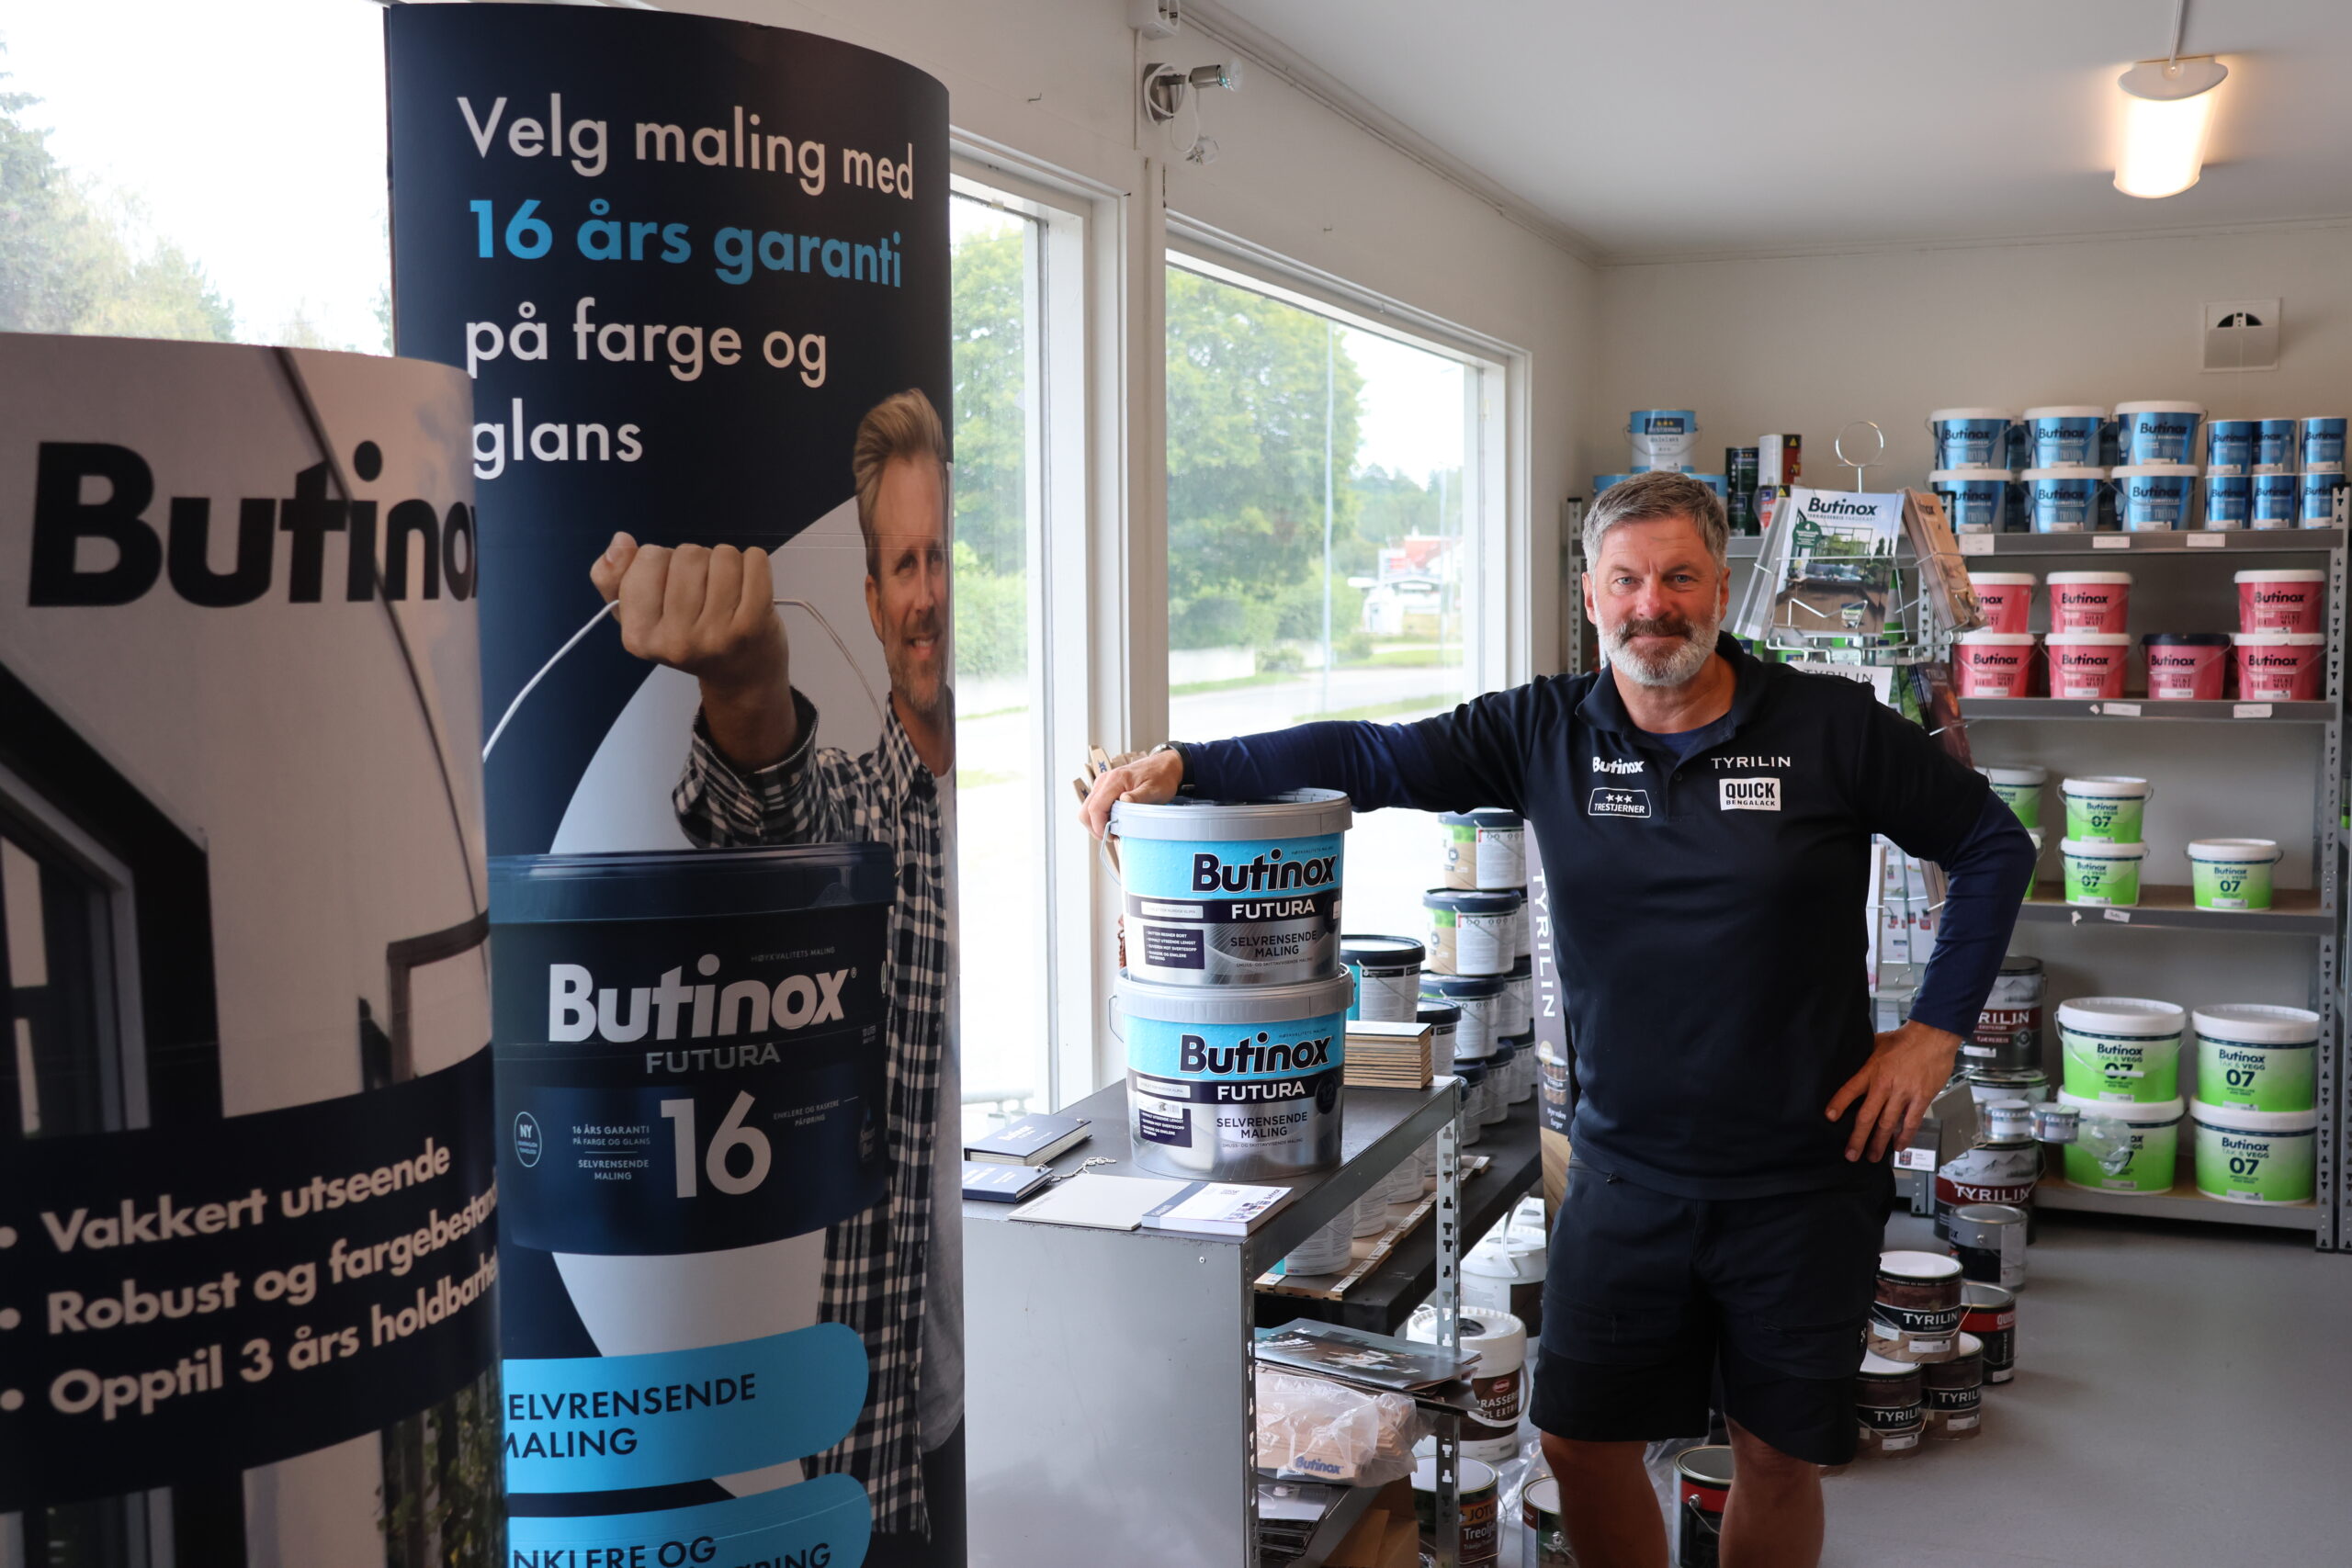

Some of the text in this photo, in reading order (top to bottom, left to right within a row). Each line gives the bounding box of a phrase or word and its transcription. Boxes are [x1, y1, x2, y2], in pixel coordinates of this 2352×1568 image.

[457, 93, 914, 200] Velg maling med
[469, 197, 902, 288] 16 års garanti
[466, 297, 827, 389] på farge og
[472, 397, 643, 480] glans
[1944, 427, 1990, 440] Butinox
[1956, 488, 1992, 501] utinox
[1808, 497, 1878, 515] Butinox
[28, 440, 477, 608] Butino
[1978, 592, 2003, 604] inox
[2062, 592, 2108, 604] Butinox
[2255, 591, 2304, 604] Butinox
[1973, 653, 2018, 665] Butinox
[2062, 653, 2109, 666] Butinox
[2151, 655, 2196, 666] Butinox
[2249, 654, 2299, 667] Butinox
[1592, 756, 1645, 774] Butinox
[1711, 756, 1791, 770] TYRILIN
[1725, 783, 1775, 799] QUICK
[1594, 803, 1645, 814] TRESTJERNER
[2086, 802, 2118, 810] Butinox
[2092, 816, 2111, 828] 07
[1192, 848, 1339, 893] Butinox
[2082, 875, 2100, 887] 07
[2220, 880, 2241, 892] 07
[1231, 899, 1316, 919] FUTURA
[1230, 930, 1317, 947] SELVRENSENDE
[1532, 868, 1555, 1018] TYRILIN
[1255, 945, 1299, 958] MALING
[548, 953, 849, 1043] Butinox
[1978, 1011, 2030, 1025] RILIN
[1179, 1031, 1332, 1075] Butinox
[2098, 1043, 2143, 1055] Butinox
[2219, 1049, 2266, 1064] Butinox
[646, 1043, 781, 1074] FUTURA
[2226, 1069, 2256, 1088] 07
[1217, 1080, 1306, 1100] FUTURA
[805, 1105, 815, 1113] OG
[1216, 1111, 1307, 1128] SELVRENSENDE
[519, 1124, 533, 1138] NY
[572, 1123, 650, 1134] 16 ÅRS GARANTI
[1240, 1126, 1288, 1139] MALING
[607, 1138, 620, 1146] OG
[661, 1089, 772, 1199] 16
[2222, 1137, 2269, 1152] Butinox
[578, 1159, 650, 1168] SELVRENSENDE
[2230, 1156, 2259, 1176] 07
[594, 1171, 632, 1180] MALING
[40, 1136, 449, 1254] Vakkert utseende
[1954, 1185, 2030, 1202] TYRILIN
[47, 1270, 241, 1336] Robust
[253, 1261, 316, 1306] og
[1903, 1312, 1958, 1325] TYRILIN
[49, 1246, 498, 1422] Opptil 3 års holdbarhe
[508, 1372, 756, 1421] ELVRENSENDE
[1477, 1393, 1517, 1408] RASSER
[1295, 1457, 1343, 1475] Butinox
[513, 1536, 718, 1568] NKLERE OG
